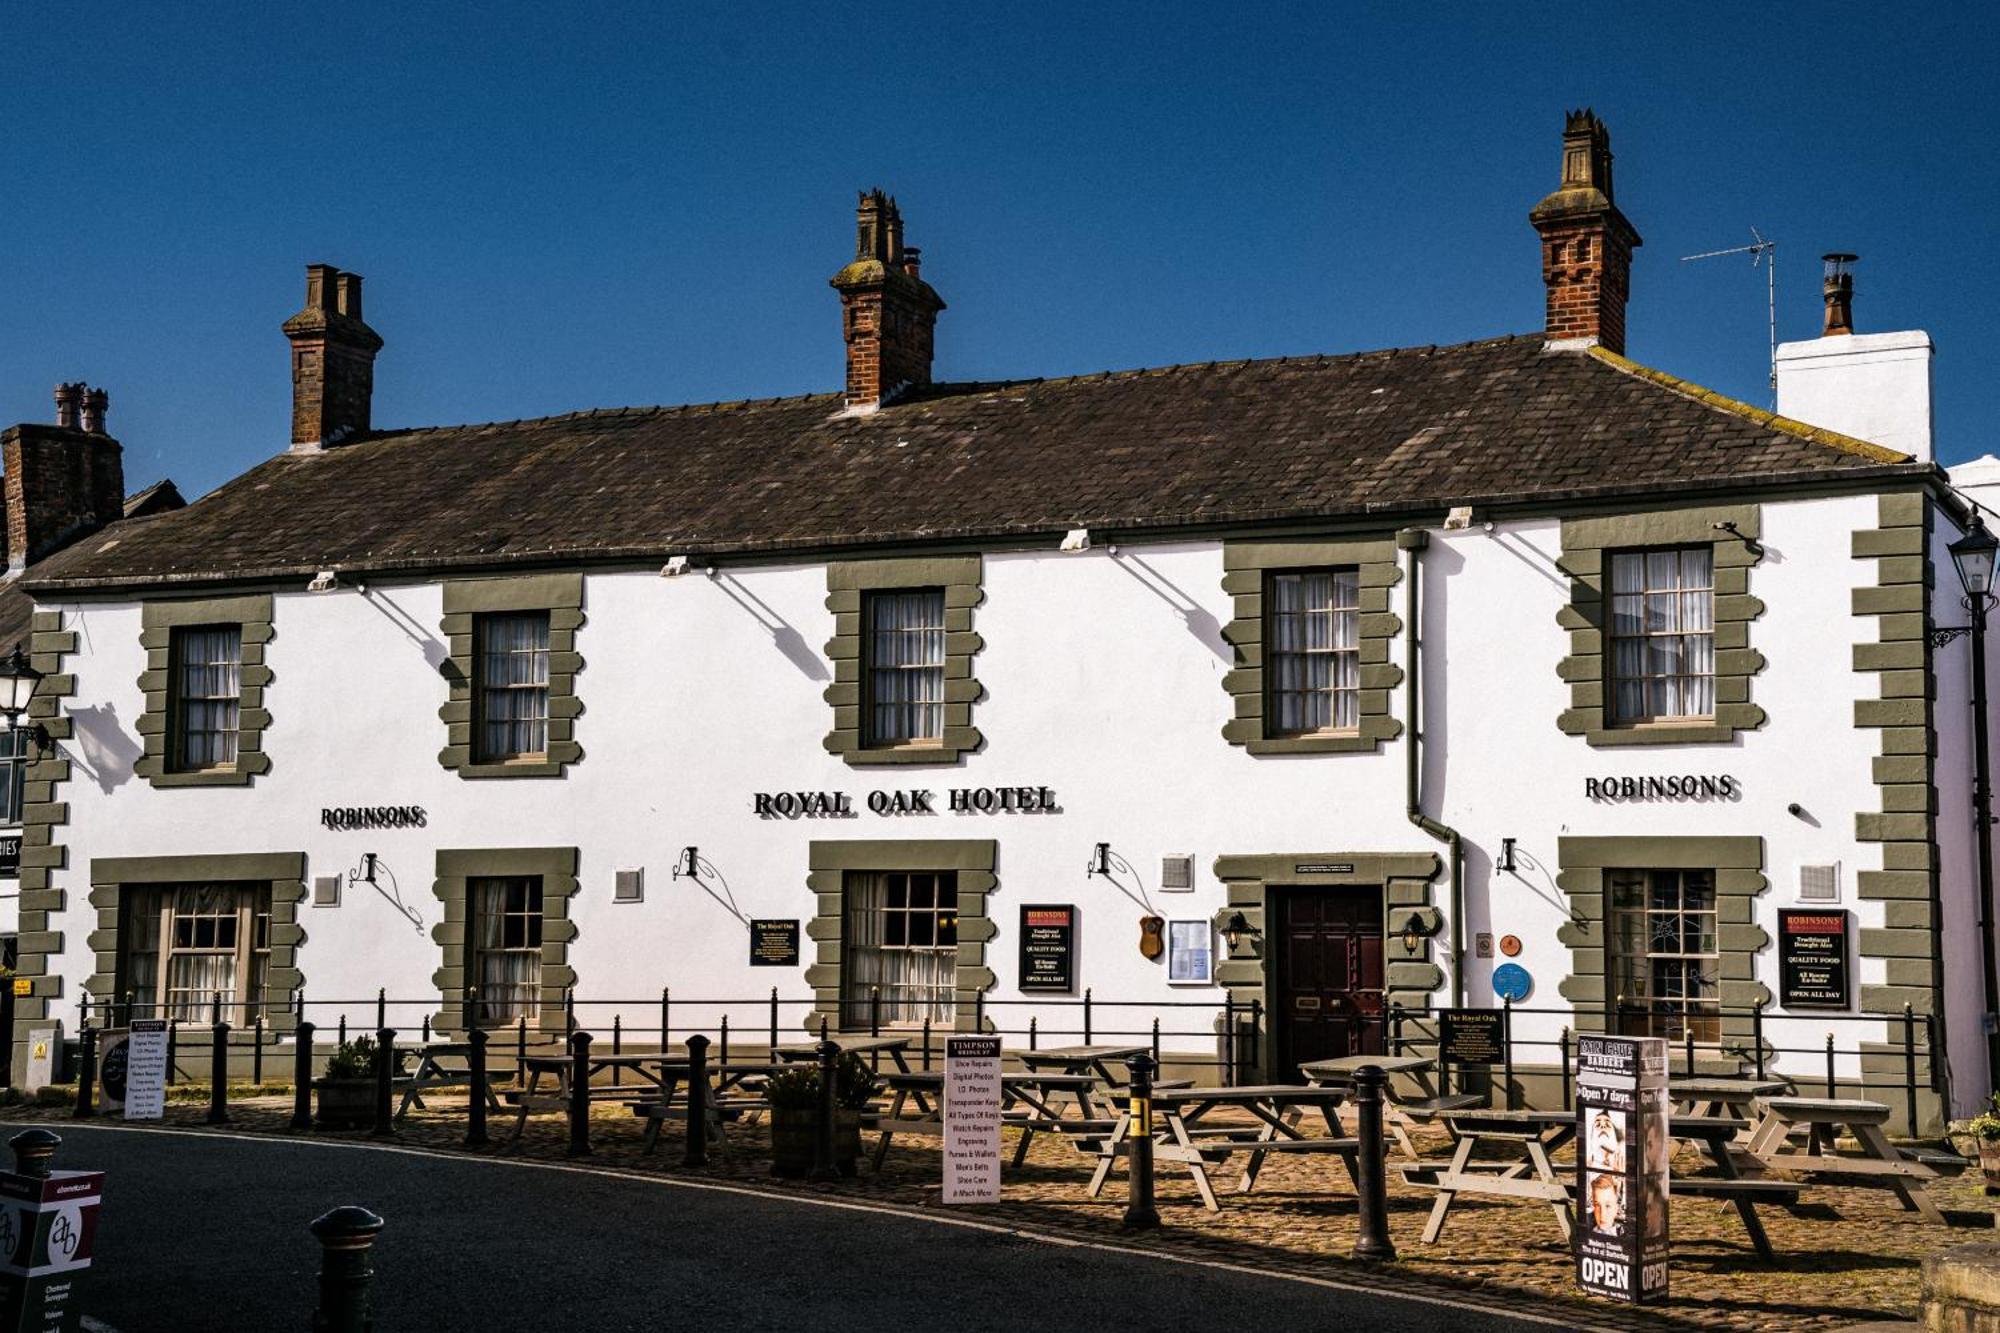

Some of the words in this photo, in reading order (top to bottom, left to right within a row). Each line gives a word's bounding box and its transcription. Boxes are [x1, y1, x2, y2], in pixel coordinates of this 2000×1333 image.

[1585, 774, 1732, 798] ROBINSONS
[753, 791, 850, 815] ROYAL
[867, 789, 932, 813] OAK
[948, 786, 1056, 811] HOTEL
[321, 806, 421, 825] ROBINSONS
[0, 840, 17, 856] IES
[1787, 916, 1840, 925] ROBINSONS
[1026, 945, 1049, 953] QUALITY
[1050, 945, 1067, 953] FOOD
[1825, 991, 1841, 999] DAY
[1448, 1014, 1460, 1022] The
[1462, 1014, 1481, 1023] Royal
[1482, 1014, 1497, 1022] Oak
[952, 1041, 996, 1050] TIMPSON
[1587, 1055, 1624, 1068] BARBERS
[953, 1072, 973, 1082] Digital
[974, 1072, 994, 1080] Photos
[1582, 1086, 1601, 1102] Open
[1602, 1088, 1609, 1100] 7
[957, 1111, 975, 1119] Types
[1582, 1257, 1630, 1291] OPEN
[1642, 1260, 1667, 1292] OPEN
